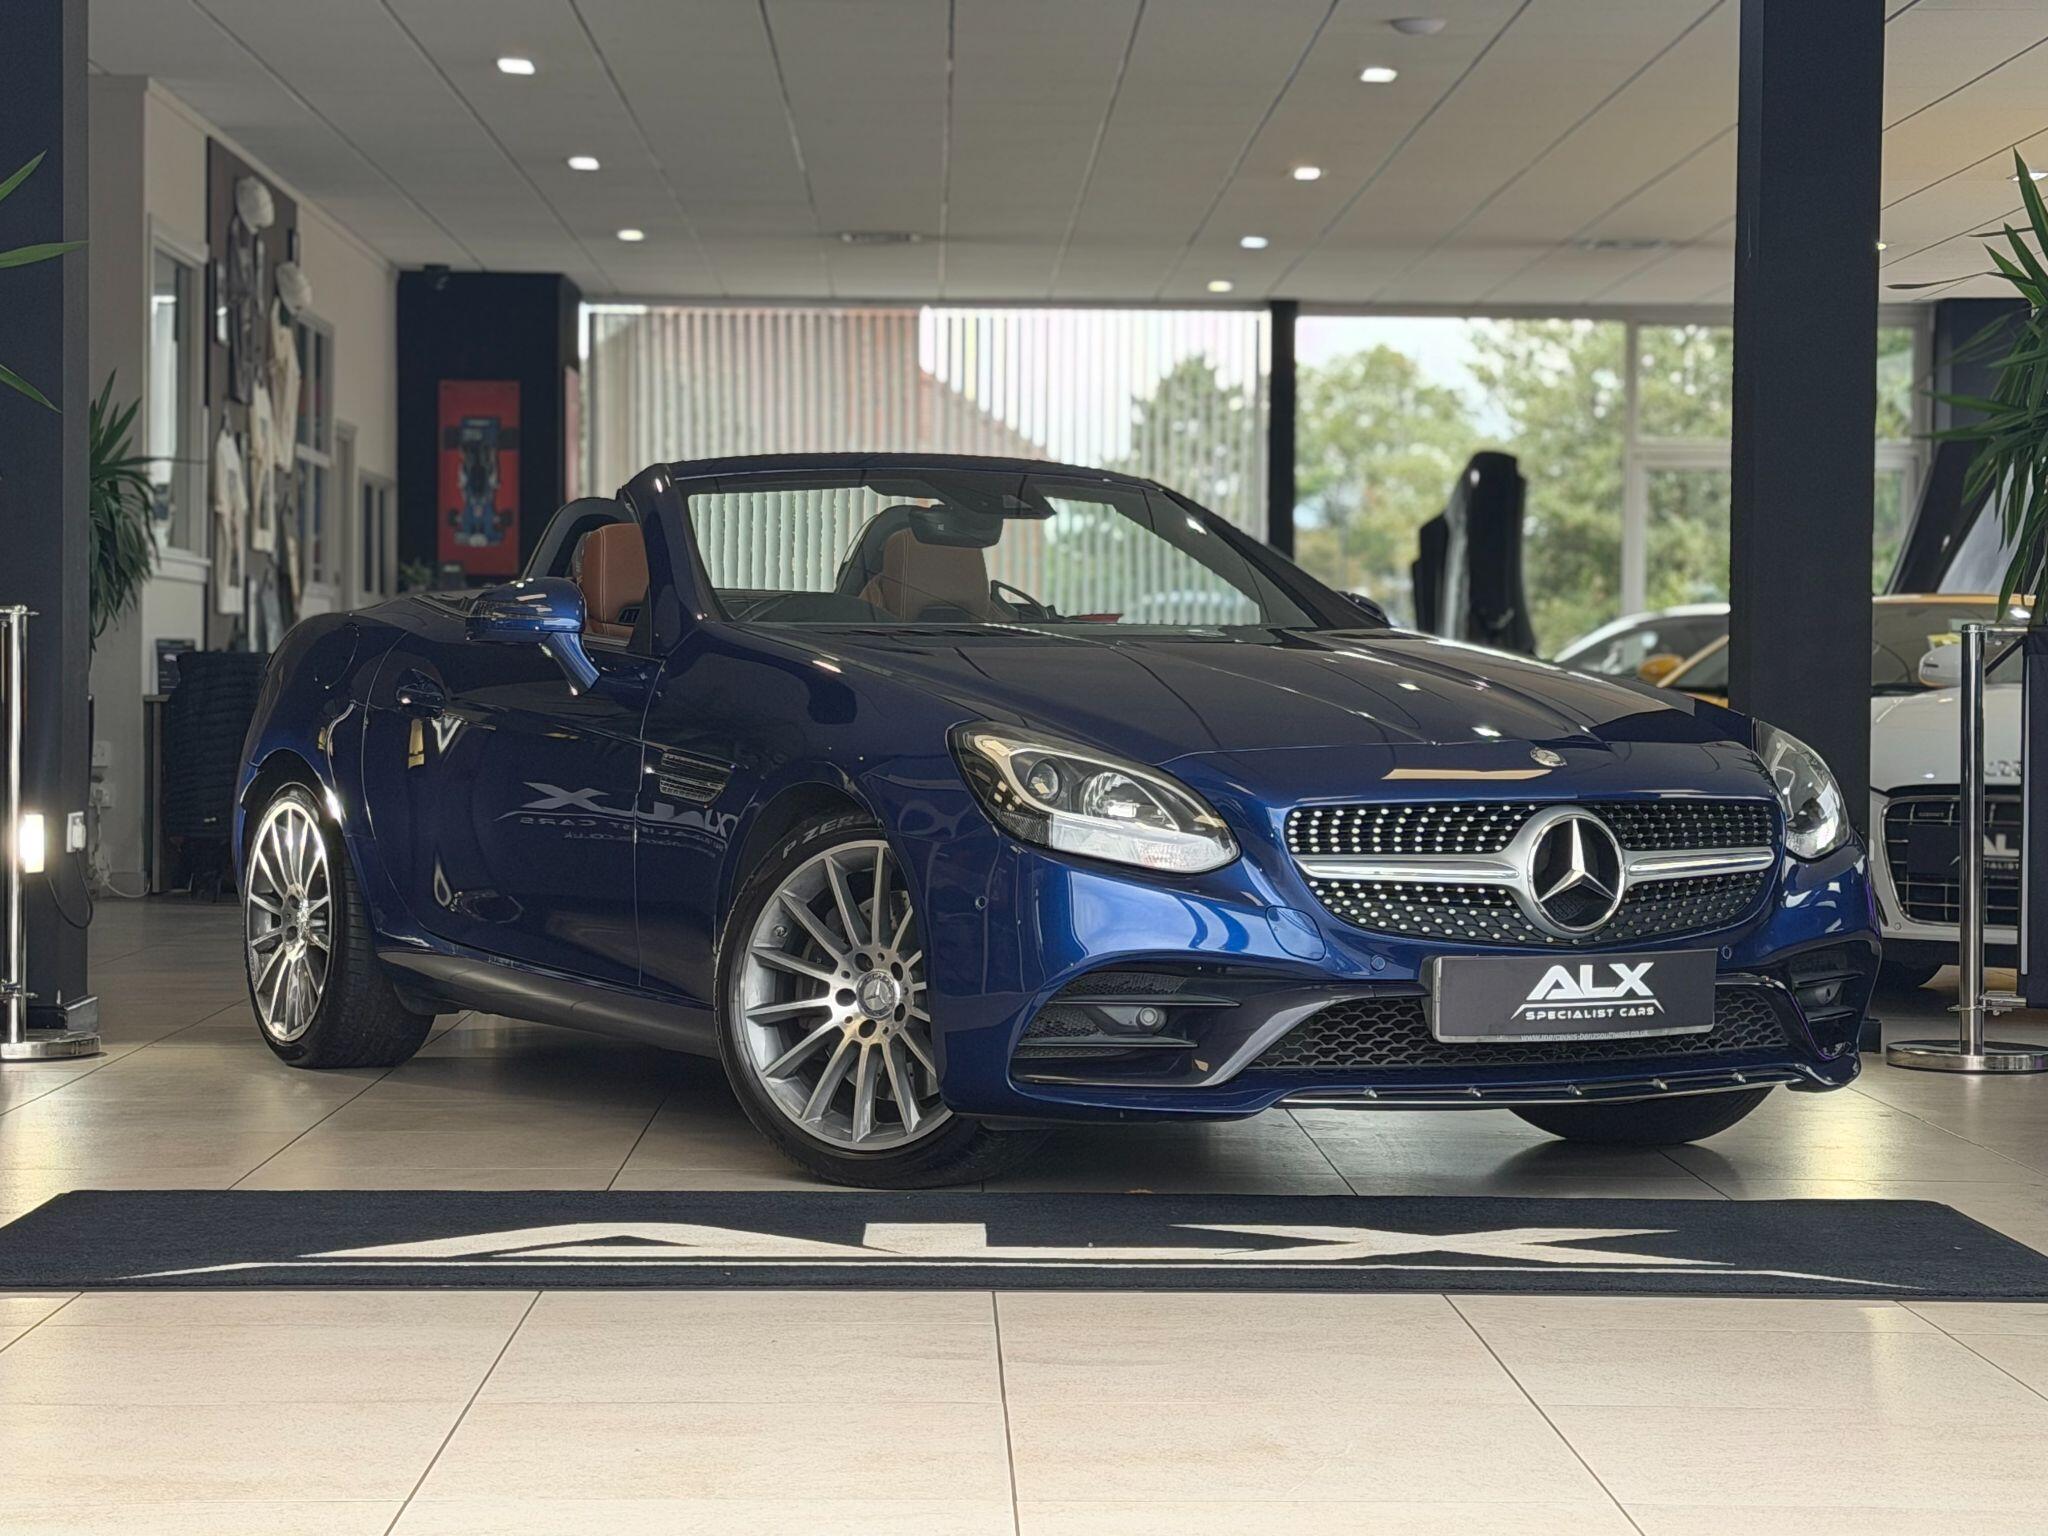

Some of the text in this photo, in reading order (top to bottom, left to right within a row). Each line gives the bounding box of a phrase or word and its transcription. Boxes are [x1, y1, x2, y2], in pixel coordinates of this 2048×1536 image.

[783, 840, 797, 859] P
[1526, 962, 1654, 1000] ALX
[1525, 1006, 1654, 1020] SPECIALIST CARS
[297, 1220, 1735, 1265] ALX
